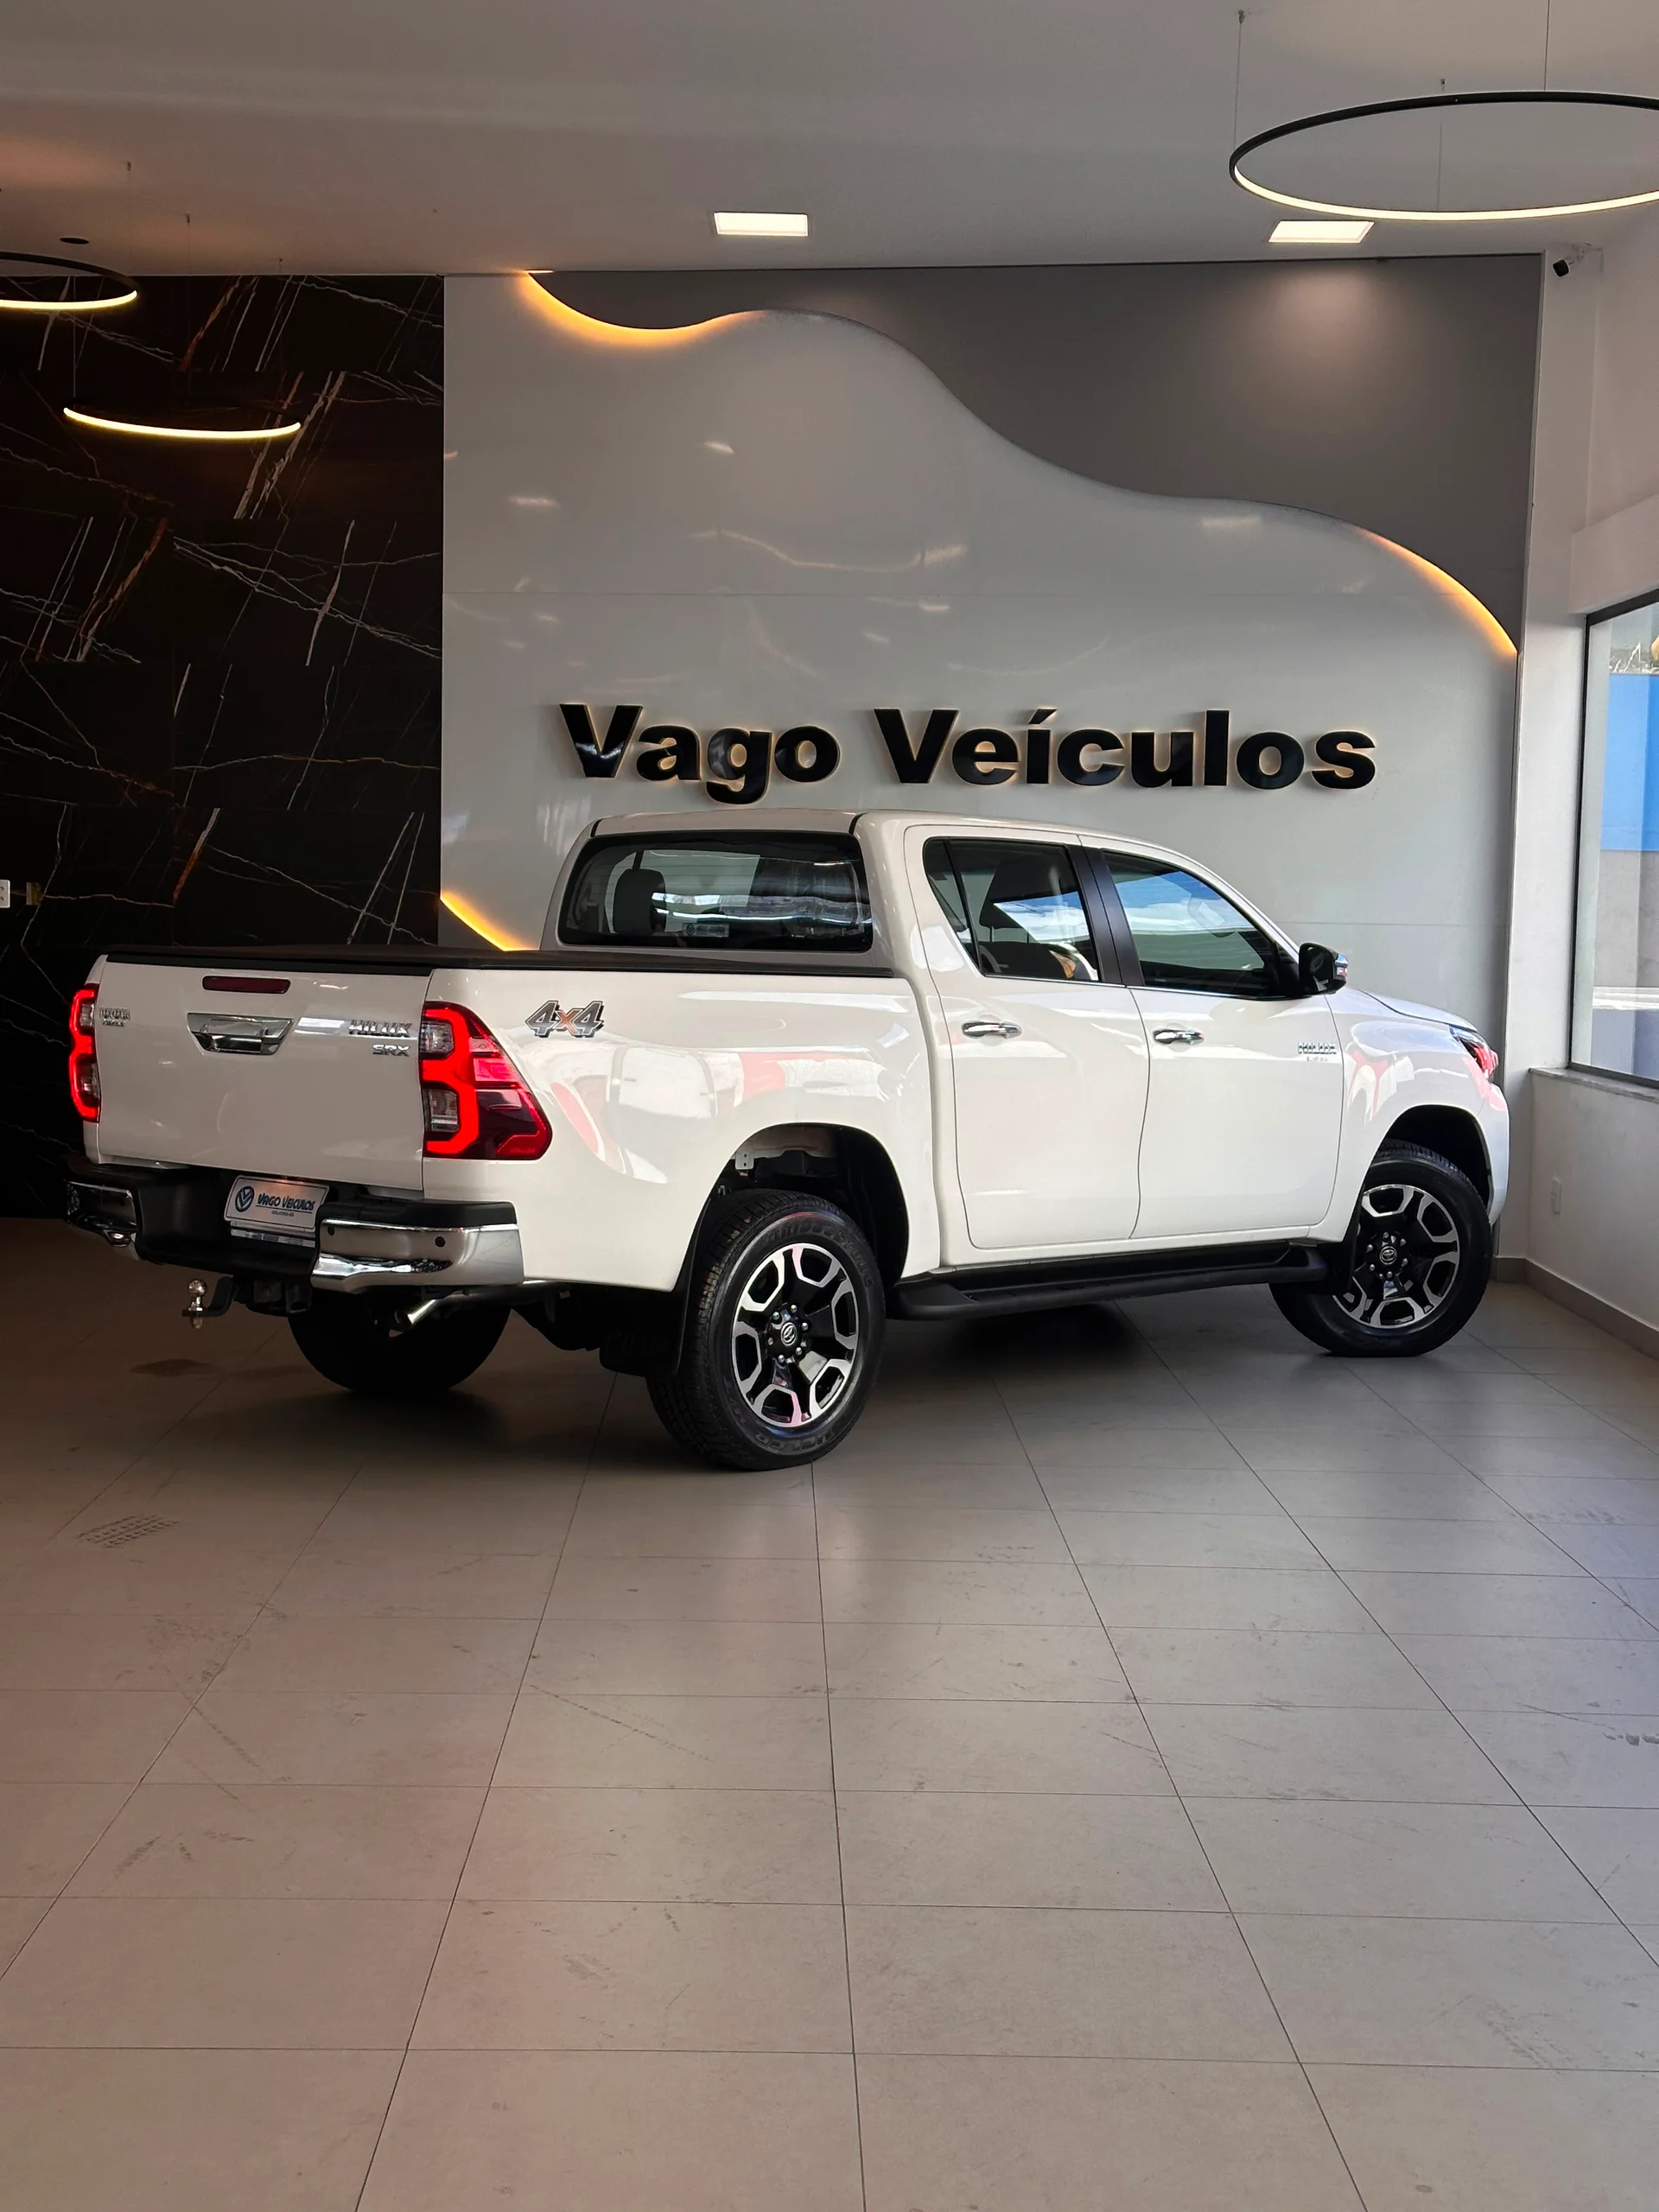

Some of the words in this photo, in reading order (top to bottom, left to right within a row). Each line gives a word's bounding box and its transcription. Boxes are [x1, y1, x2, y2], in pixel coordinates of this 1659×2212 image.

[559, 702, 842, 805] Vago
[873, 707, 1377, 791] Veículos
[524, 1000, 605, 1038] 4x4
[372, 1044, 411, 1057] SRX
